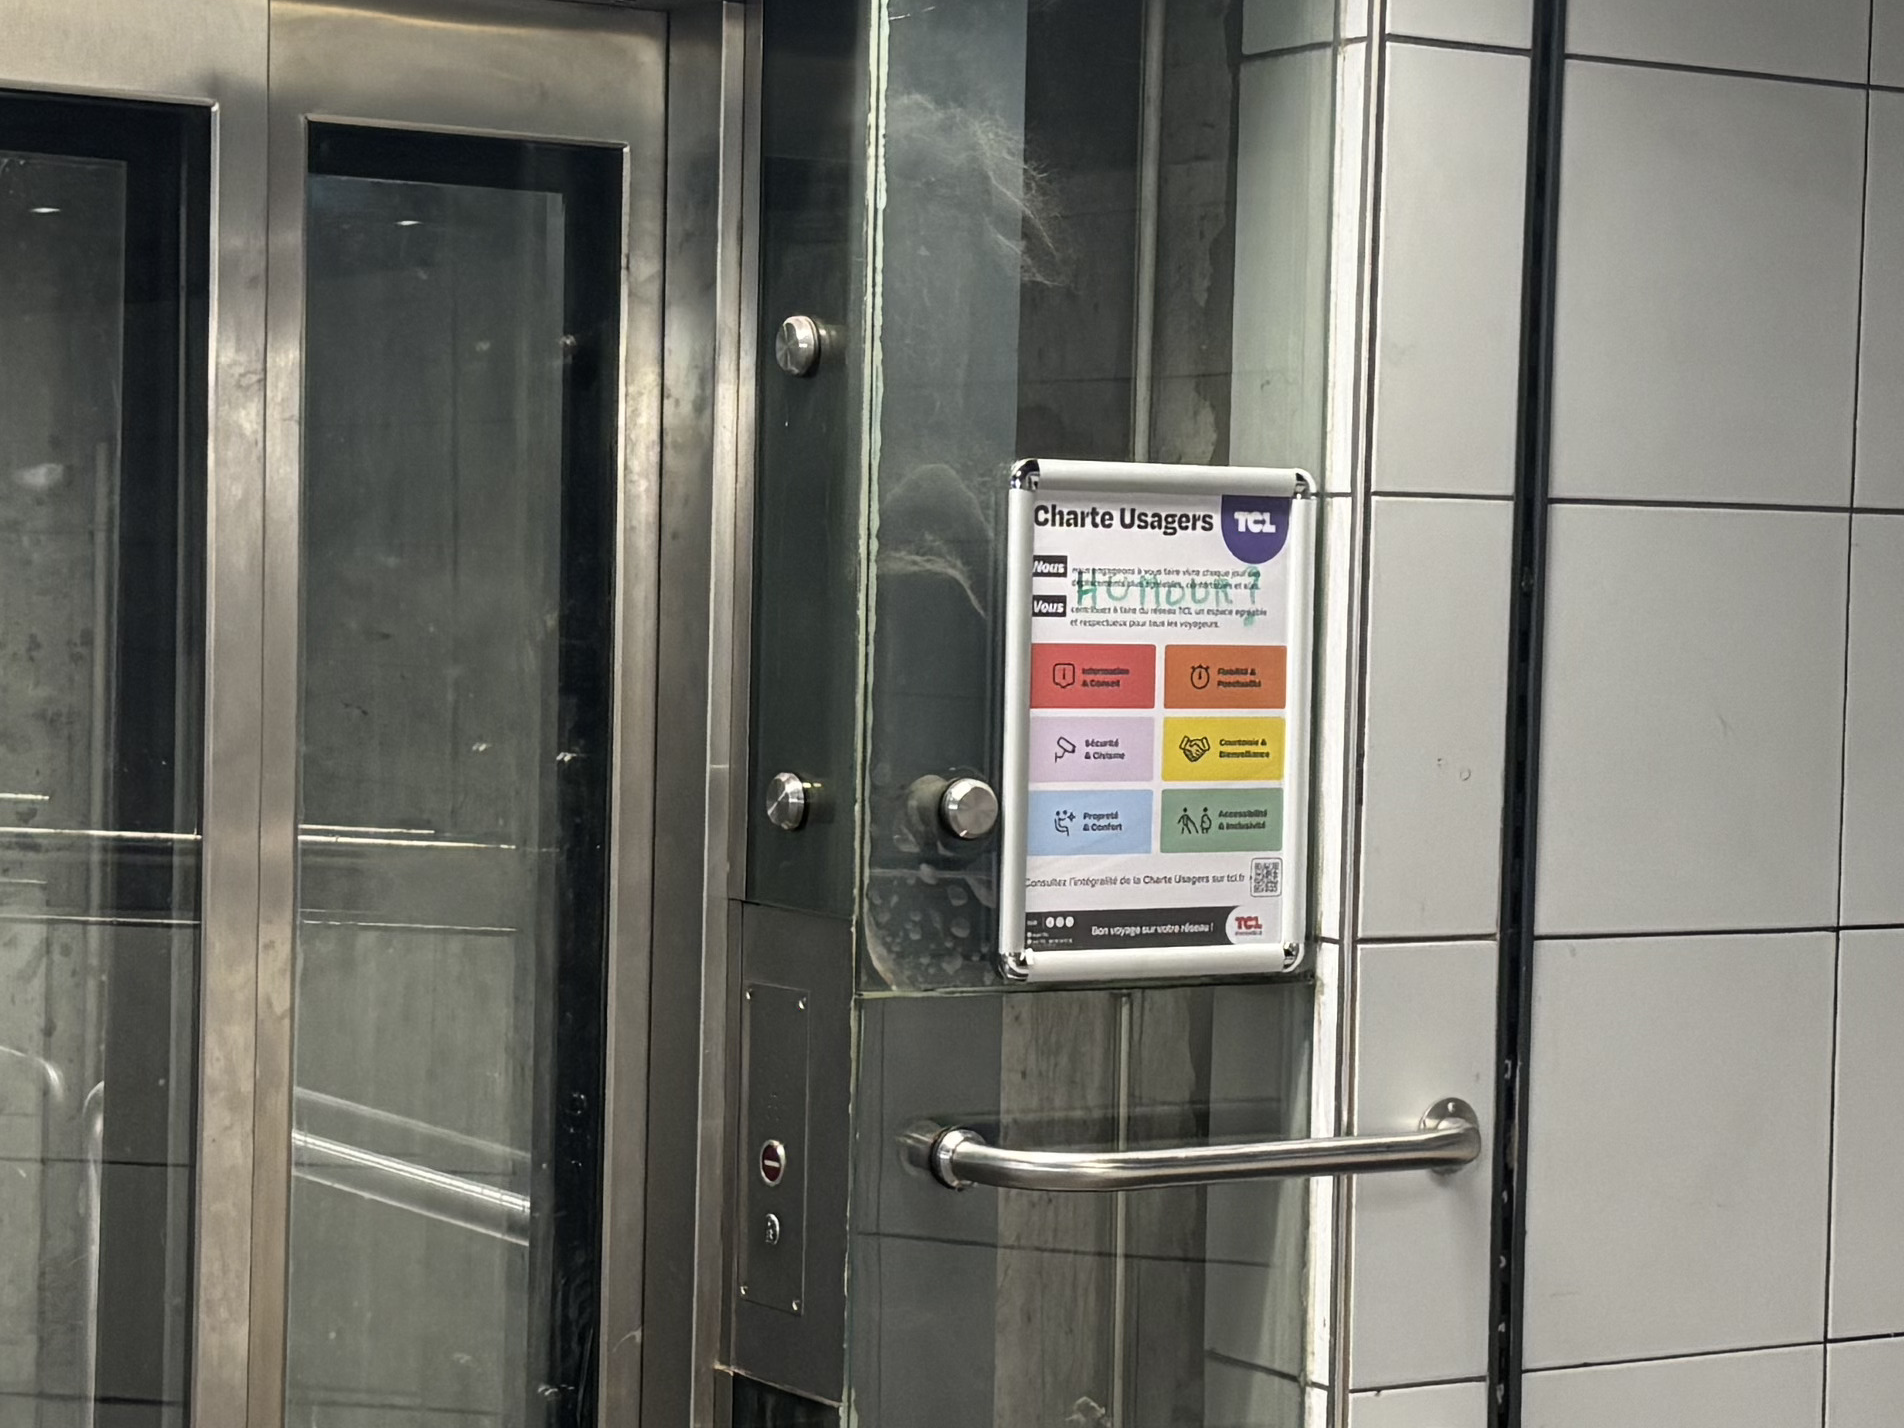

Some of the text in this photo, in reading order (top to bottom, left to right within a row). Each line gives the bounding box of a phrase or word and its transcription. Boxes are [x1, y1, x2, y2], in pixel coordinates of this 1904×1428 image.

[1034, 504, 1214, 536] Charte Usagers
[1234, 511, 1277, 534] TCL
[1032, 560, 1065, 574] Nous
[1033, 600, 1064, 613] Vous
[1119, 875, 1132, 885] de
[1133, 875, 1142, 885] la
[1142, 875, 1172, 885] Charte
[1174, 874, 1210, 886] Usagers
[1142, 925, 1156, 935] sur
[1234, 916, 1263, 930] TCL
